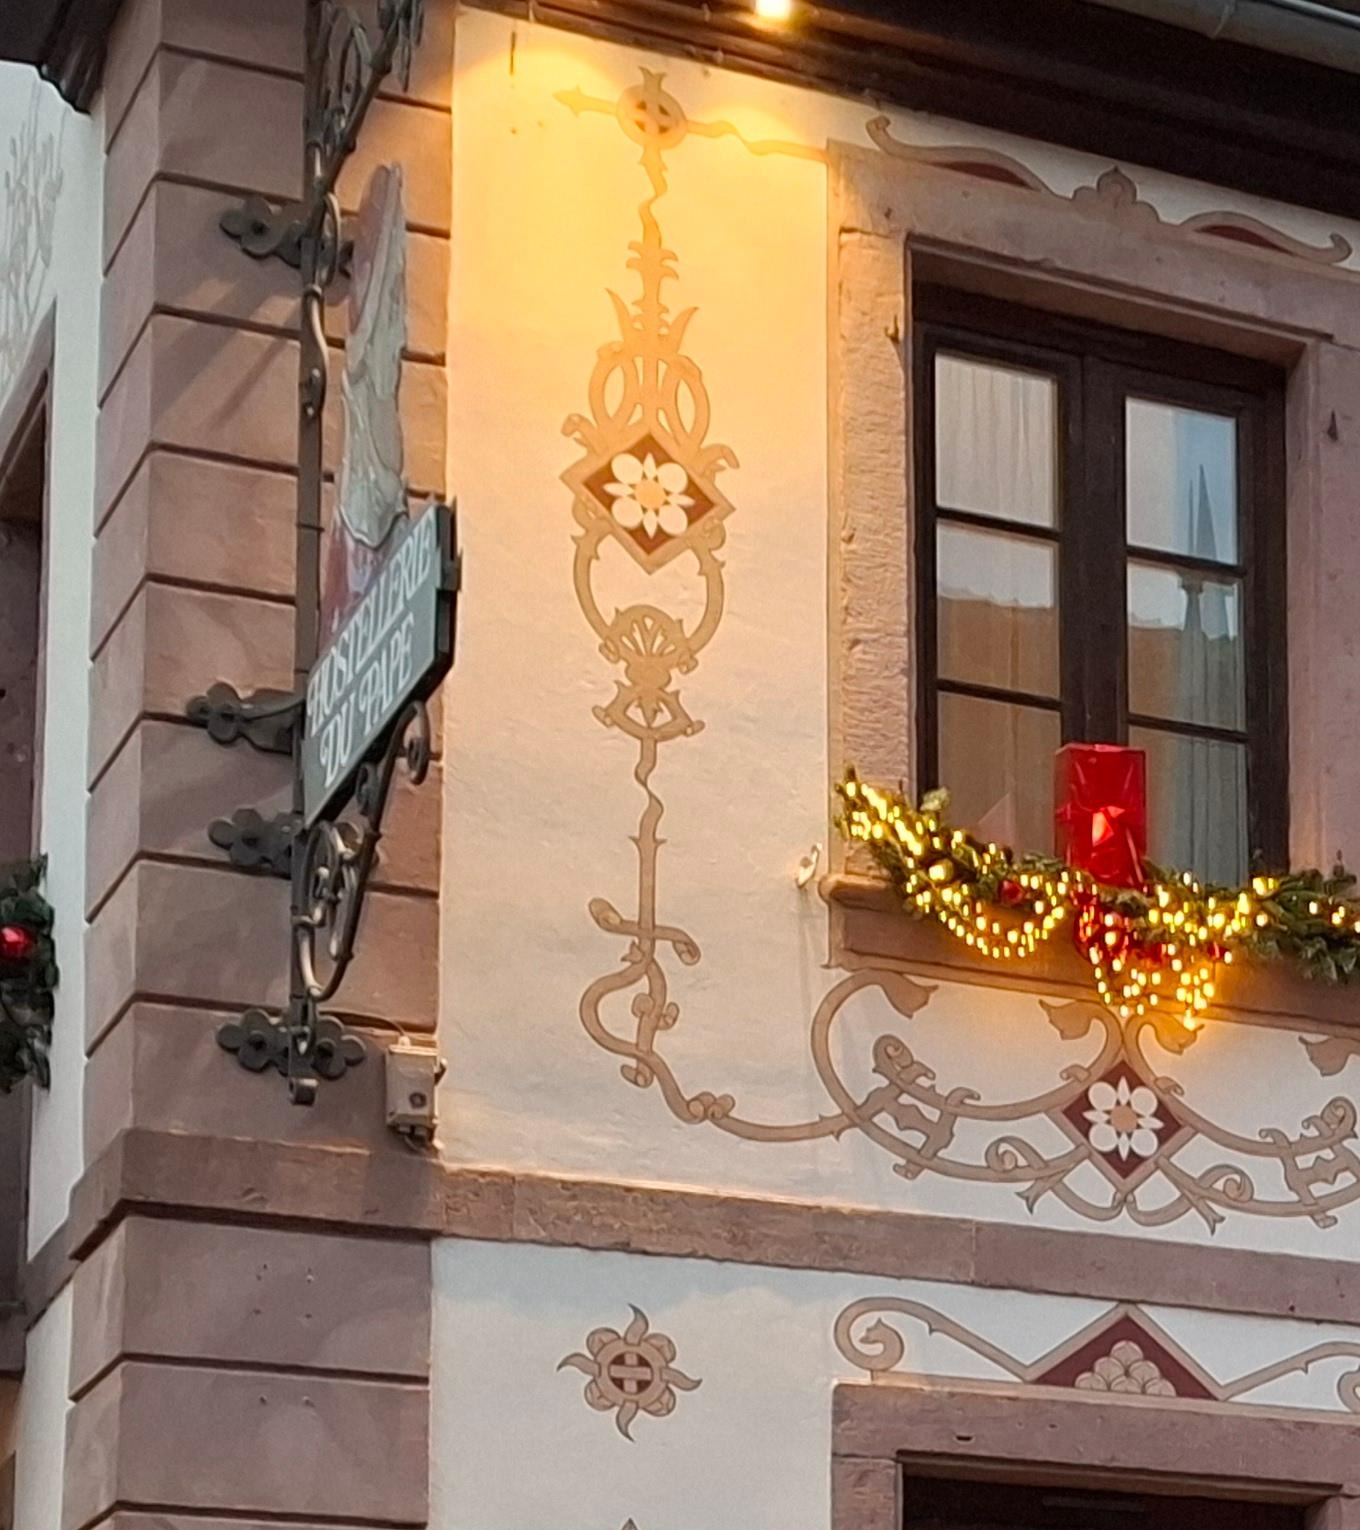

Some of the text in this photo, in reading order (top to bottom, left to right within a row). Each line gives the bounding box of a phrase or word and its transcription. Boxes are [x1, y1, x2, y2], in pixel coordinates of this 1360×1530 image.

[307, 505, 438, 738] HOSTELLERIE
[319, 611, 415, 788] DU PAPE
